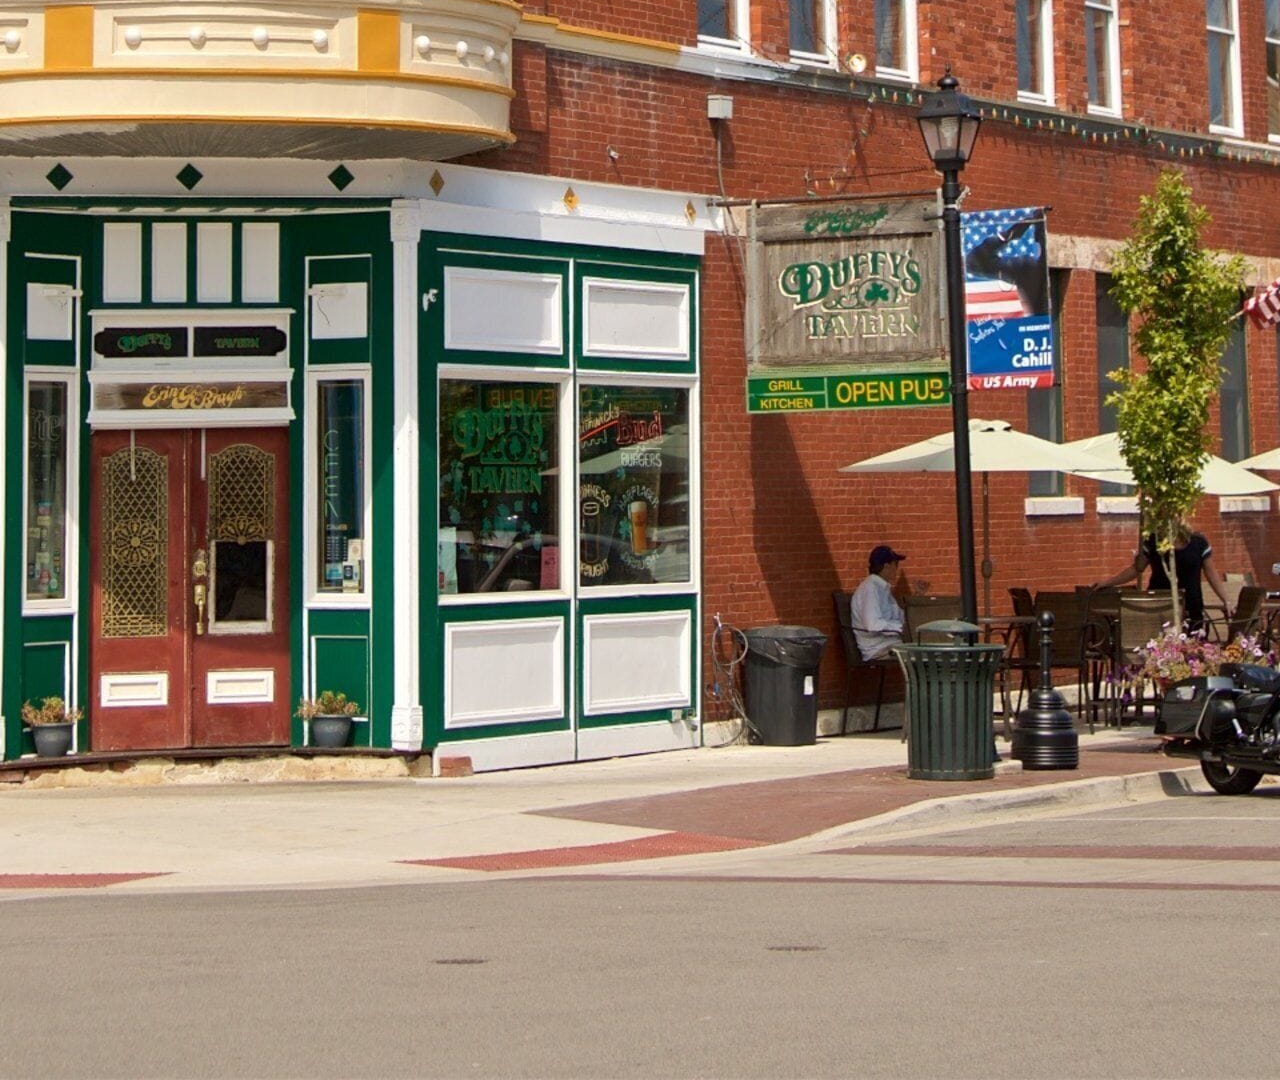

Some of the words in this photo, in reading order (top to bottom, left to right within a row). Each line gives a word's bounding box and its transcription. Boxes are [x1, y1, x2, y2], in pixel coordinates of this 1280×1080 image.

[803, 314, 920, 339] TAVERN
[1024, 338, 1038, 352] D.
[1040, 336, 1052, 351] J.
[1012, 352, 1052, 368] Cahill
[983, 376, 1001, 389] US
[1002, 375, 1039, 389] Army
[143, 385, 177, 407] Erin
[768, 380, 804, 392] GRILL
[836, 381, 894, 404] OPEN
[901, 379, 945, 400] PUB
[760, 398, 813, 410] KITCHEN
[620, 452, 663, 468] BURGERS
